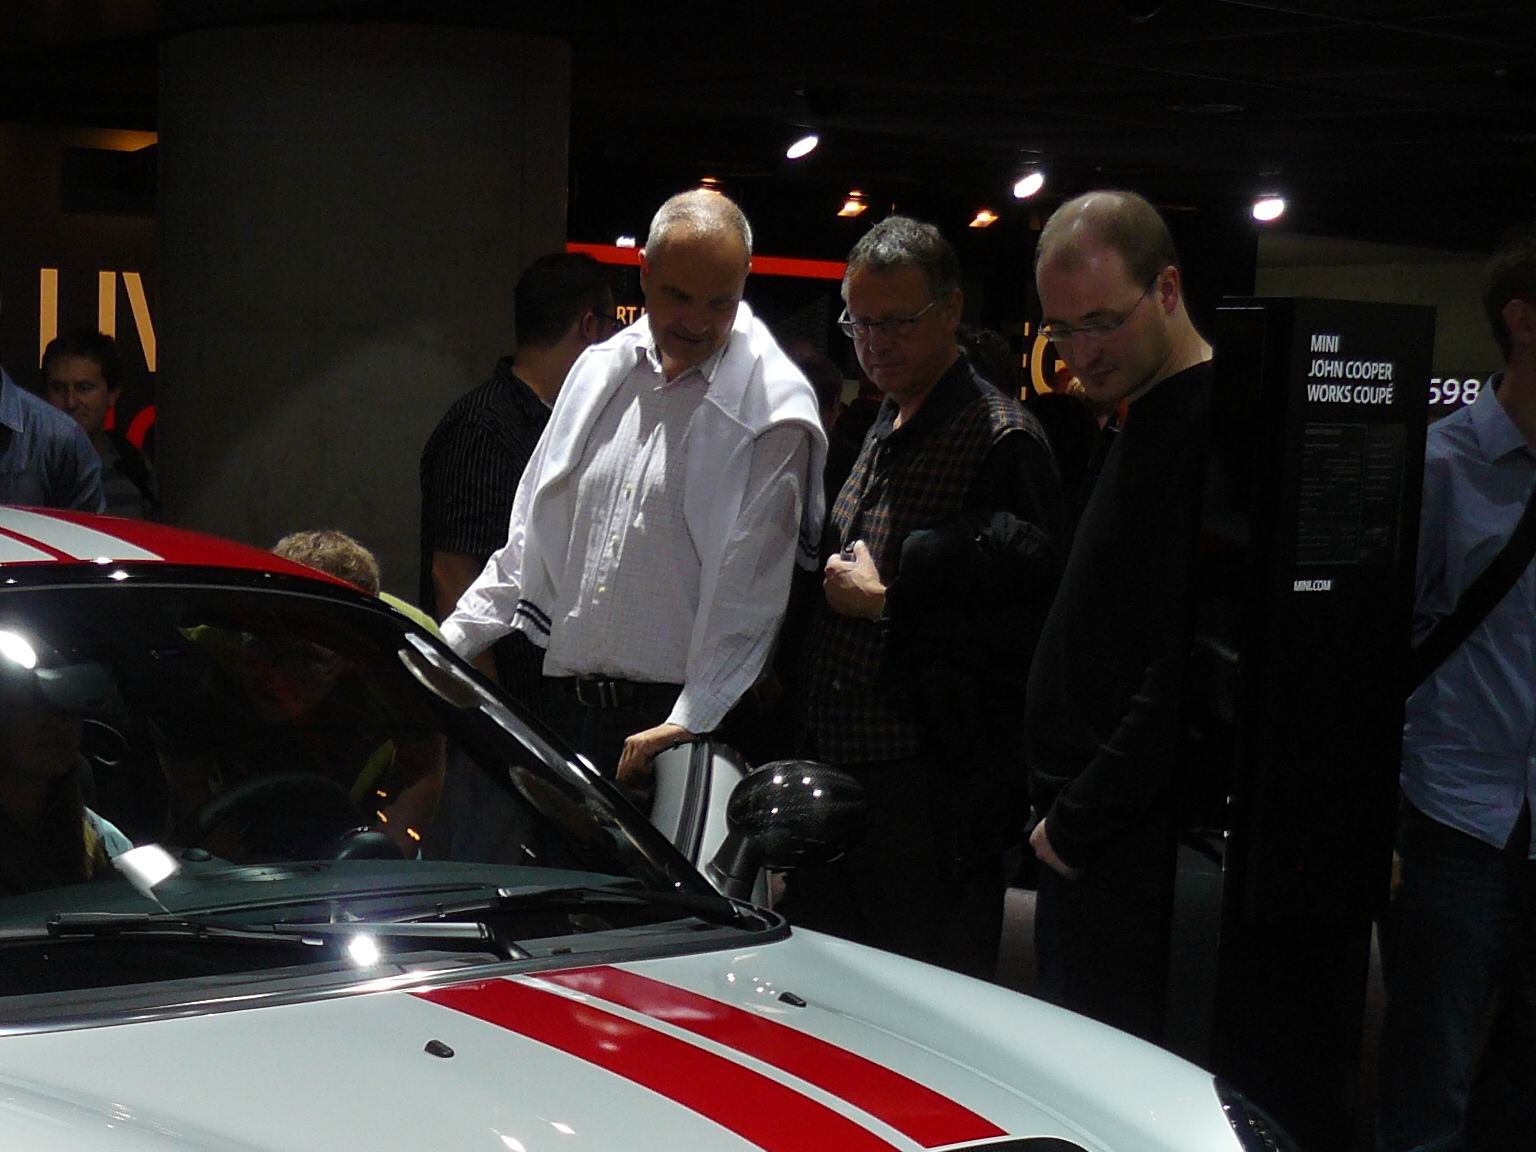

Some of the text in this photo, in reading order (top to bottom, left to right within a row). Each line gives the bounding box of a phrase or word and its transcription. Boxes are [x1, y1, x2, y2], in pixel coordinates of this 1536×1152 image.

[1310, 334, 1339, 353] MINI
[1308, 359, 1392, 381] JOHN COOPER
[1307, 383, 1393, 405] WORKS COUPÉ
